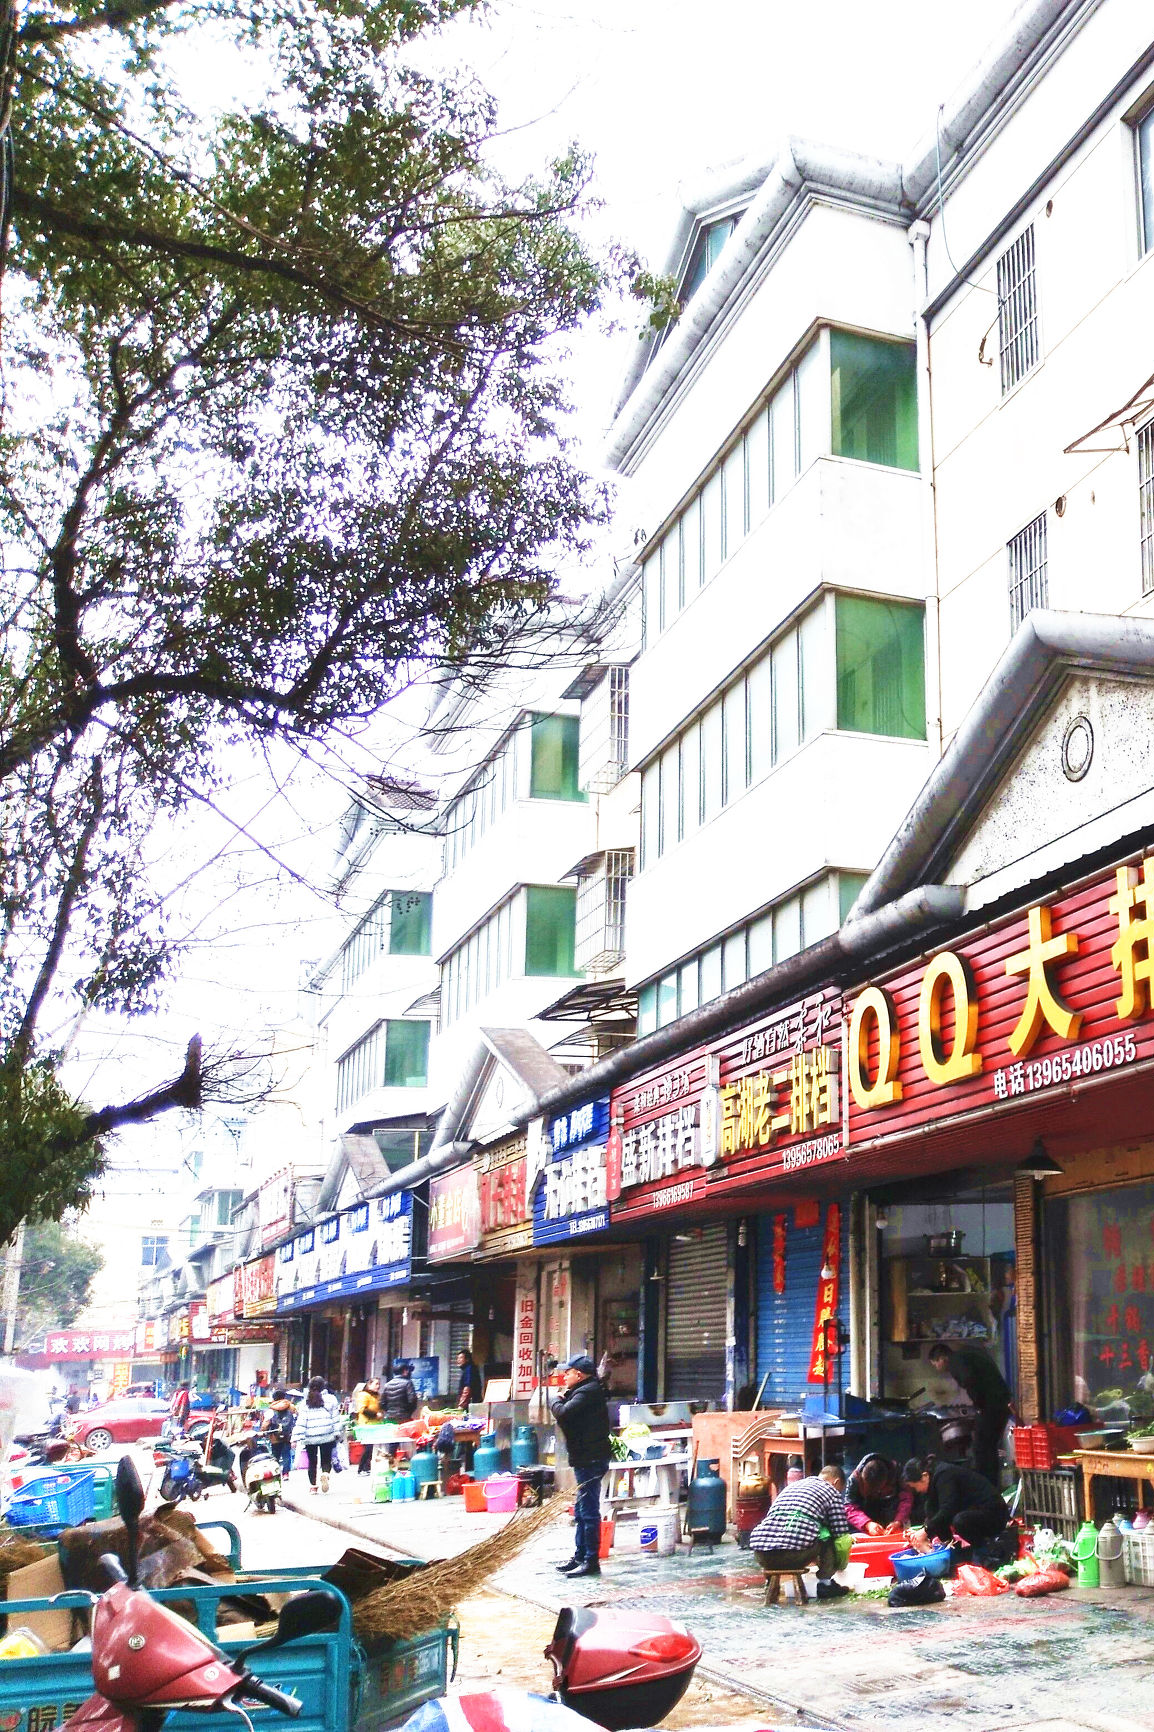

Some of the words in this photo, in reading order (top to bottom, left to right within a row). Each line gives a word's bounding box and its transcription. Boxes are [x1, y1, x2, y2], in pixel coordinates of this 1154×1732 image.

[782, 1135, 840, 1170] 13956578065
[517, 1300, 535, 1393] 旧金回收加工
